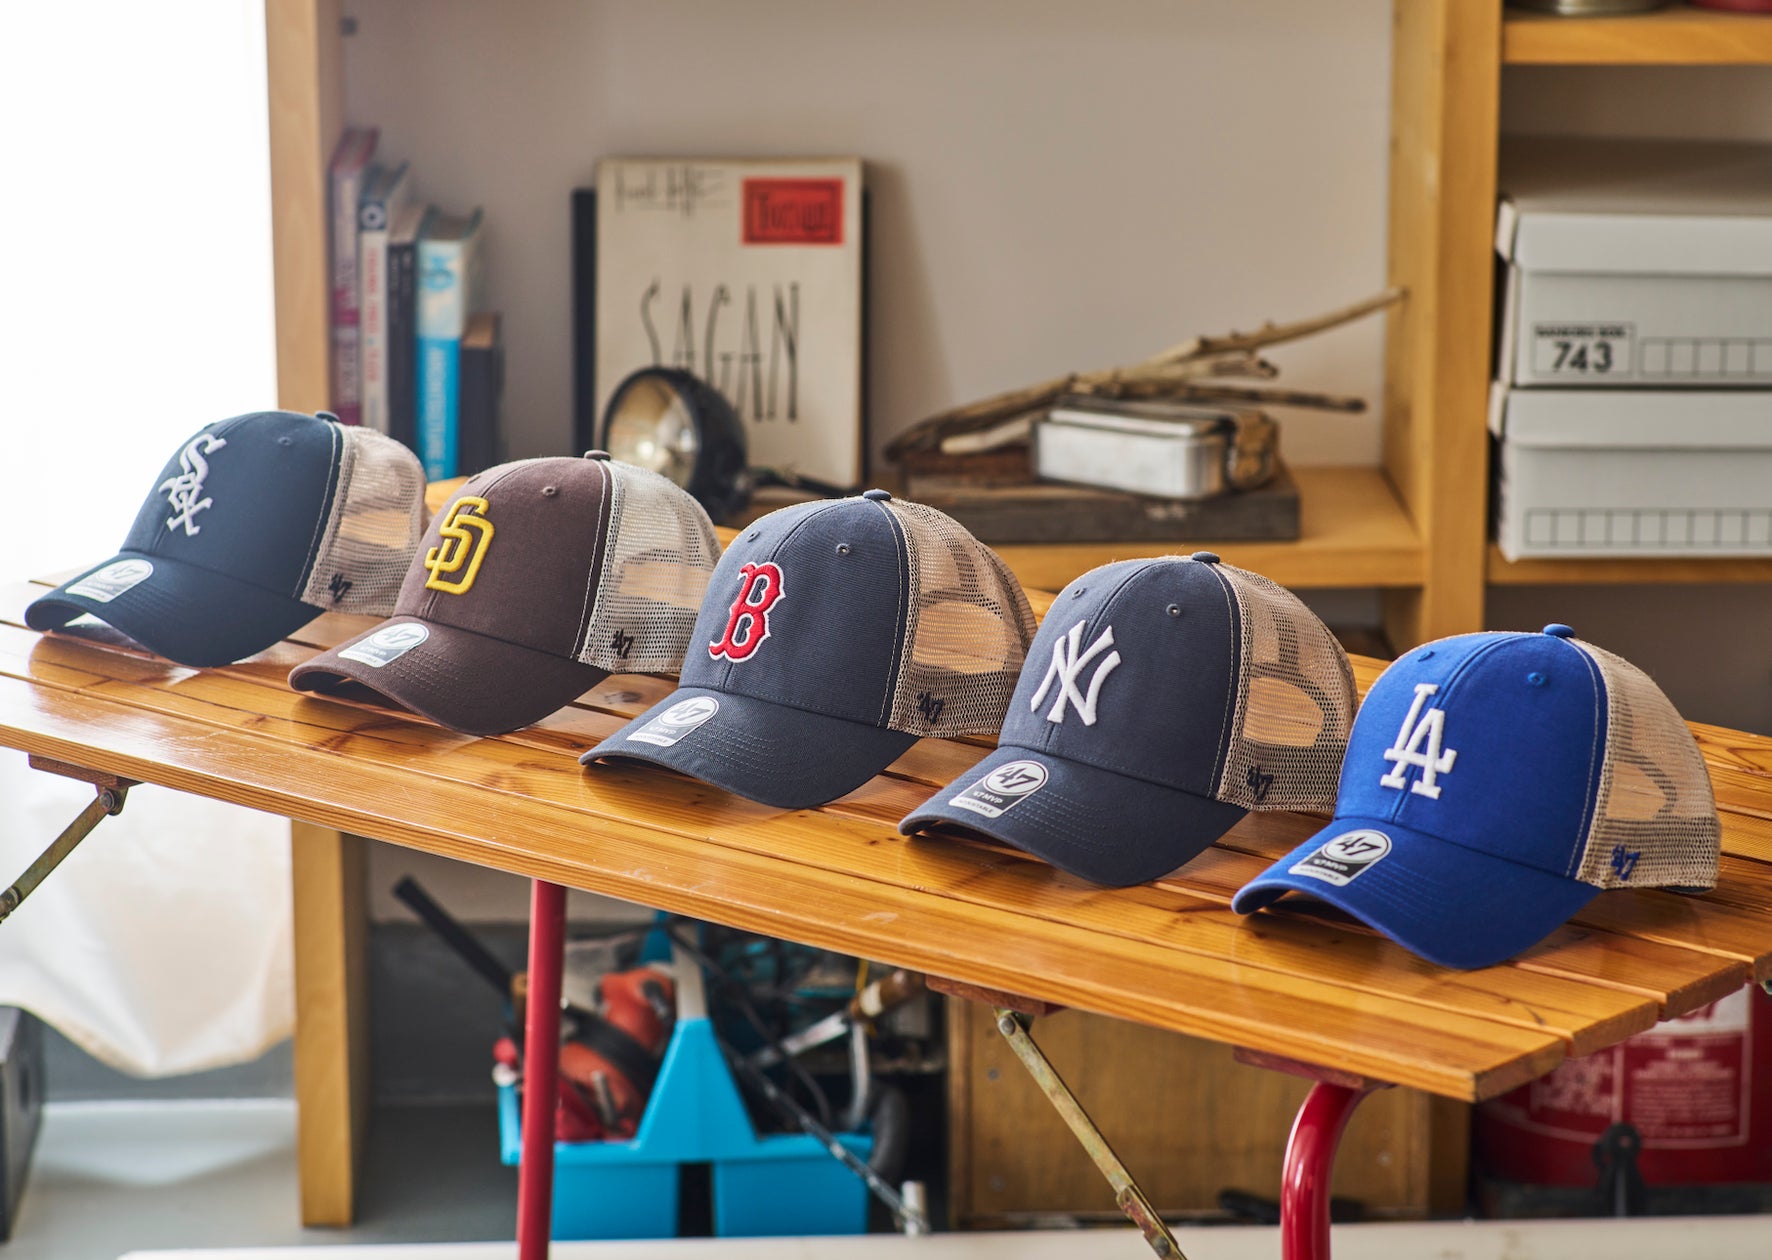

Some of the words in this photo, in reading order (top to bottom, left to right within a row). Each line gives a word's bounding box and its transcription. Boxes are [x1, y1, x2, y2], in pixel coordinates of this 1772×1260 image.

[639, 276, 799, 423] SAGAN
[1552, 341, 1613, 374] 743
[424, 496, 495, 595] SD
[708, 561, 787, 663] B
[1030, 620, 1122, 726] NY
[1380, 683, 1458, 800] LA
